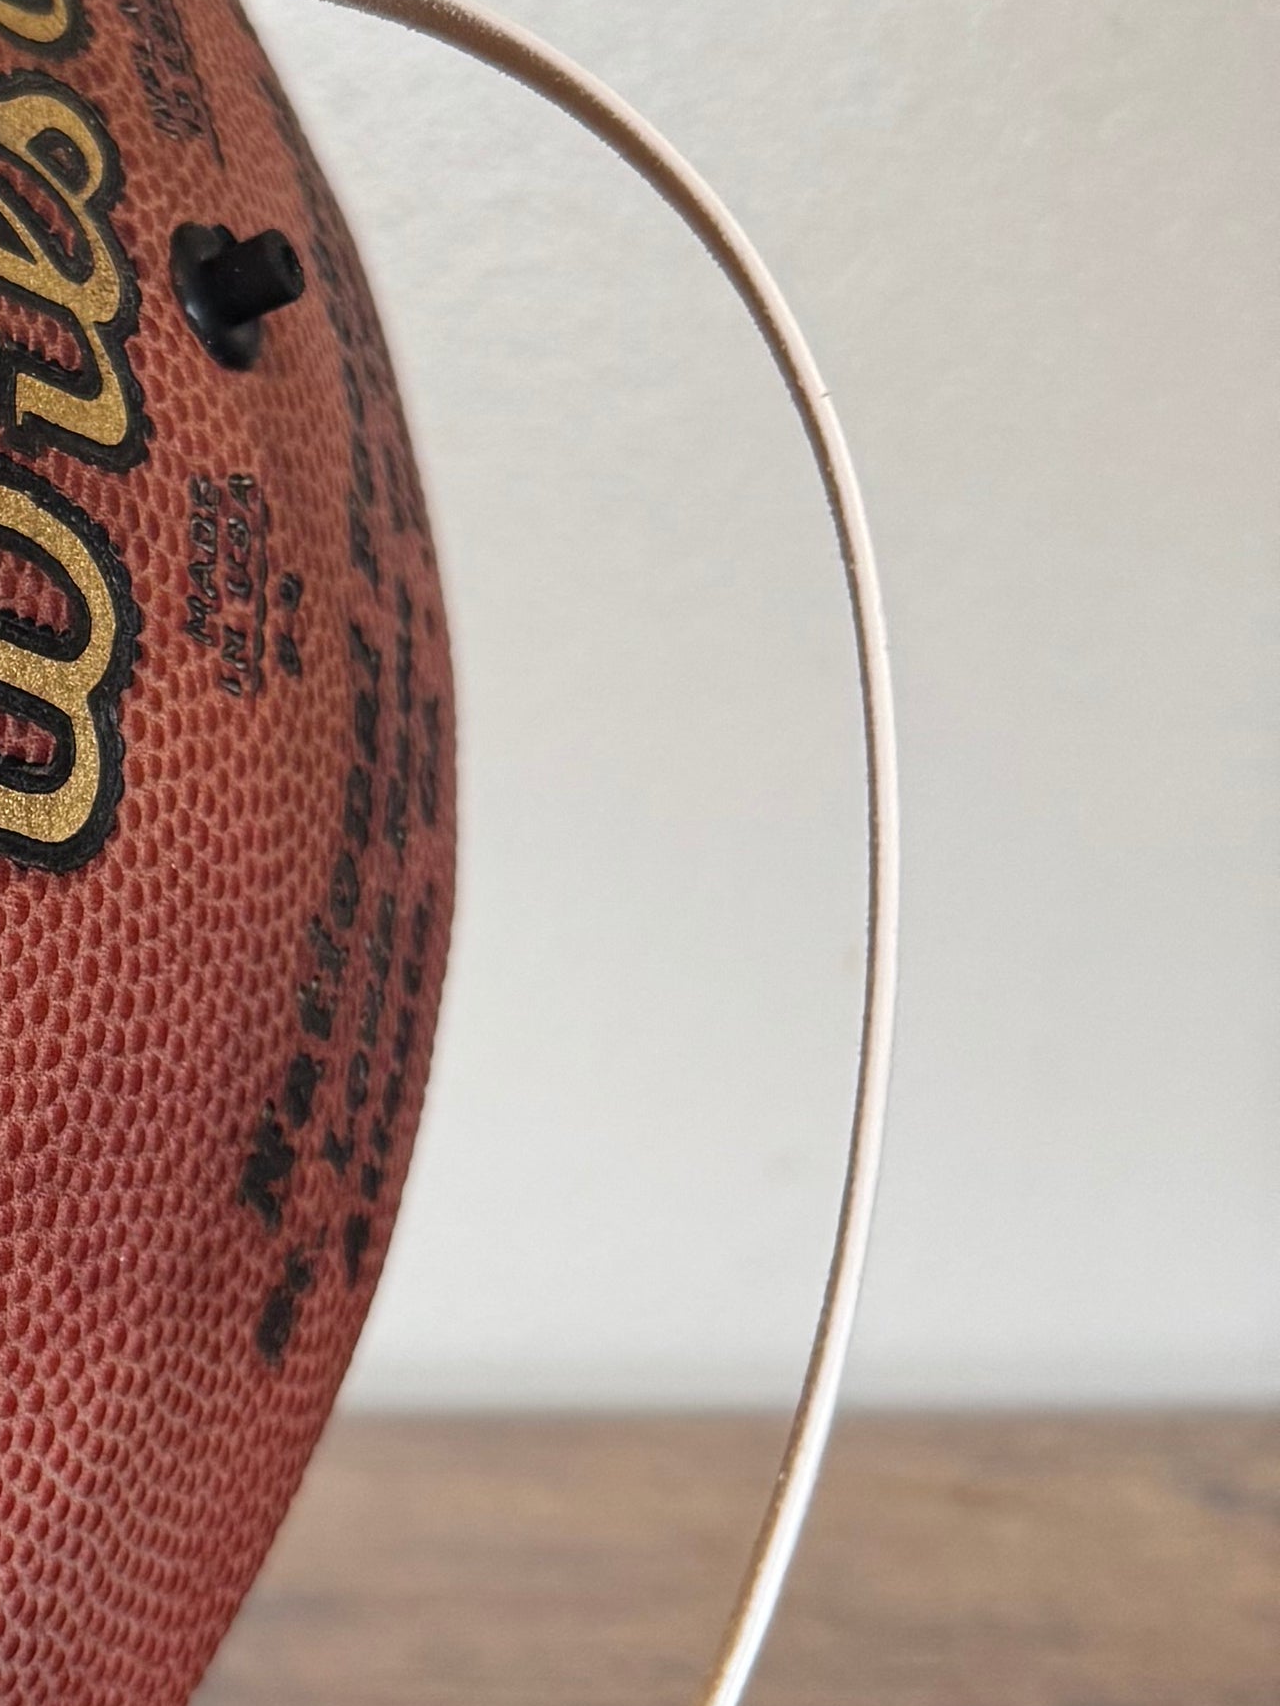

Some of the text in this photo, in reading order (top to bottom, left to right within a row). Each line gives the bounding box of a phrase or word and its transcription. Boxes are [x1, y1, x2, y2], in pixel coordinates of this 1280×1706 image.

[184, 475, 221, 647] MADE
[219, 473, 256, 696] IN USA
